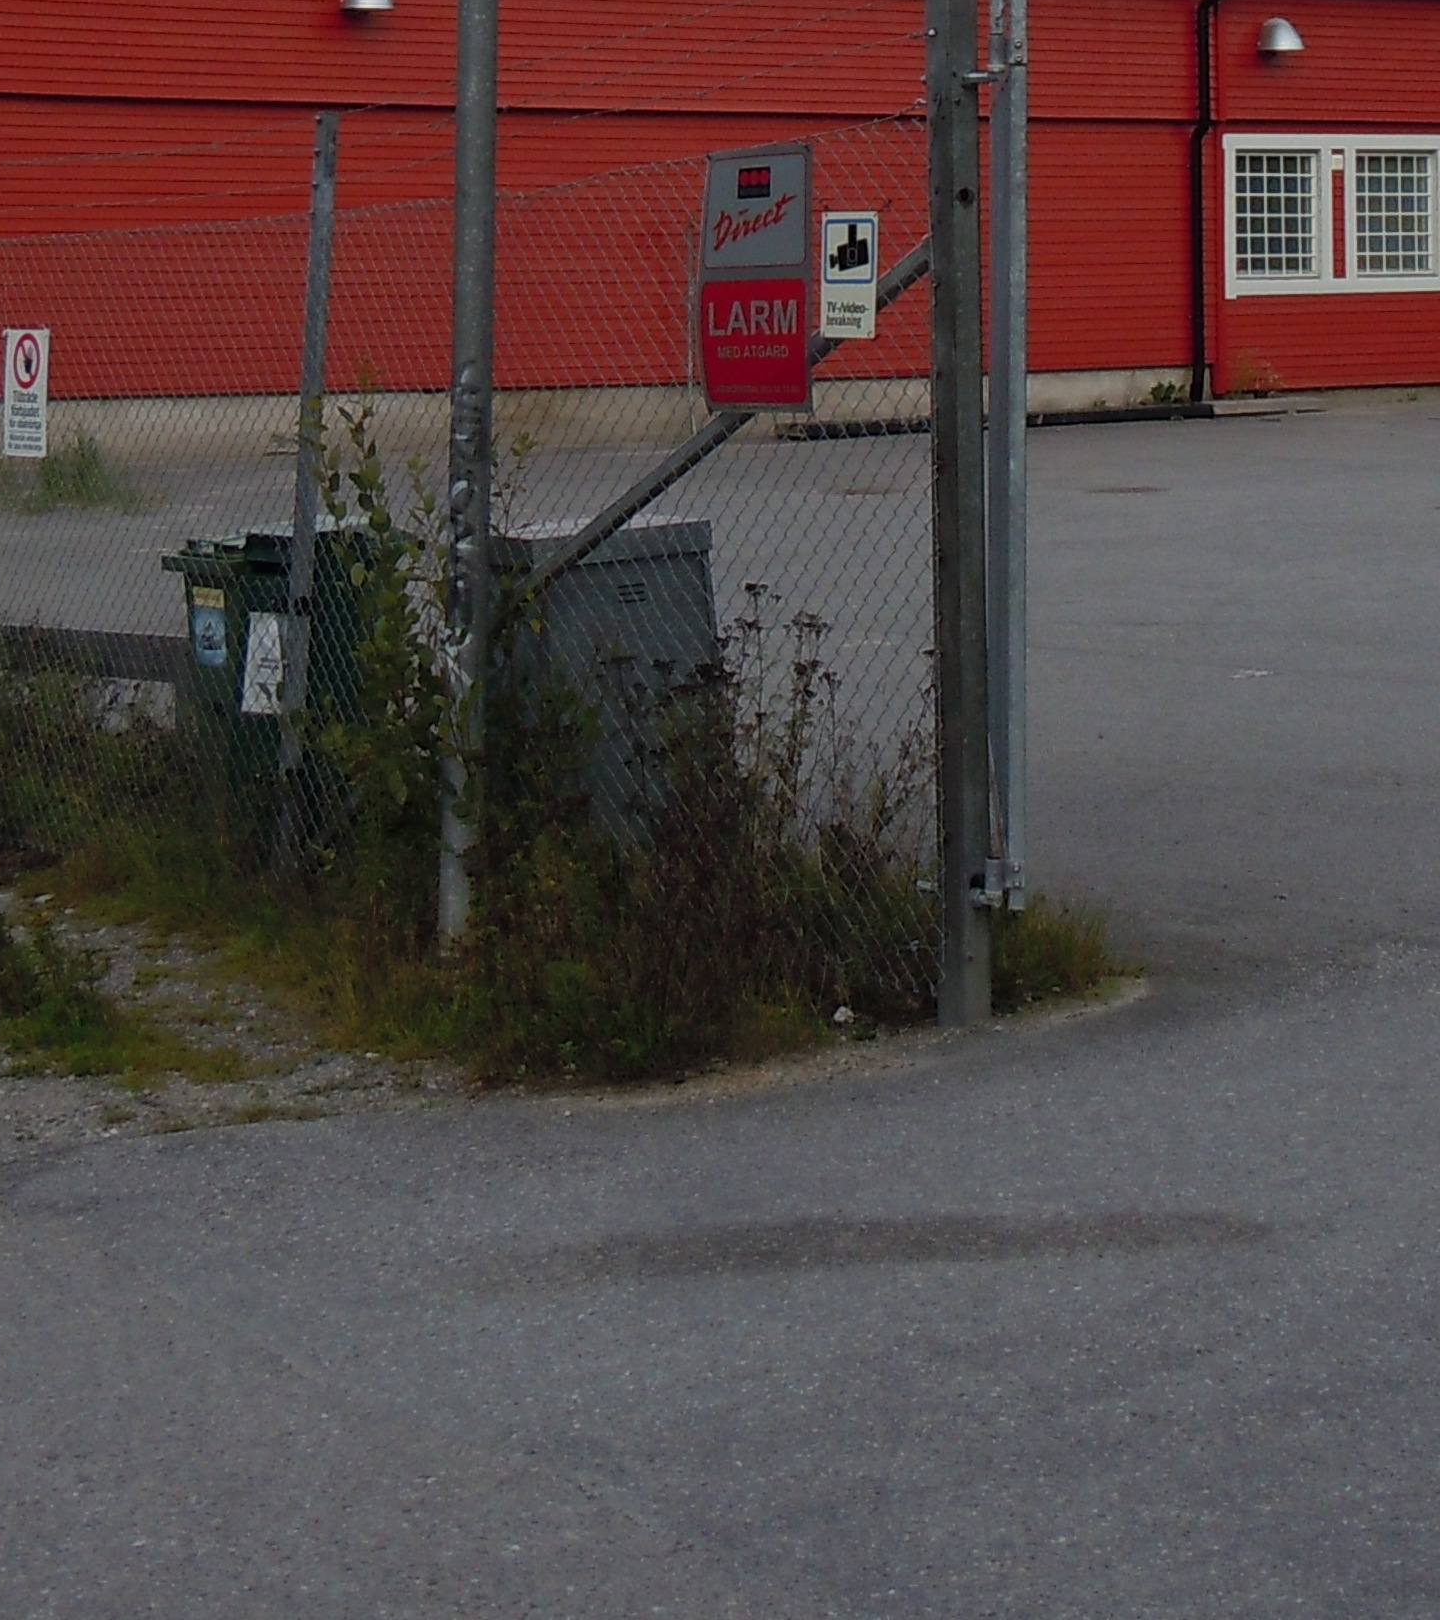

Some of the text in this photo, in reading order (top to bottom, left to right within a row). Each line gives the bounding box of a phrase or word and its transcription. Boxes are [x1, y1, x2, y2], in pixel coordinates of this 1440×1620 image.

[713, 193, 797, 252] Direct
[708, 298, 798, 337] LARM
[717, 345, 741, 359] MED
